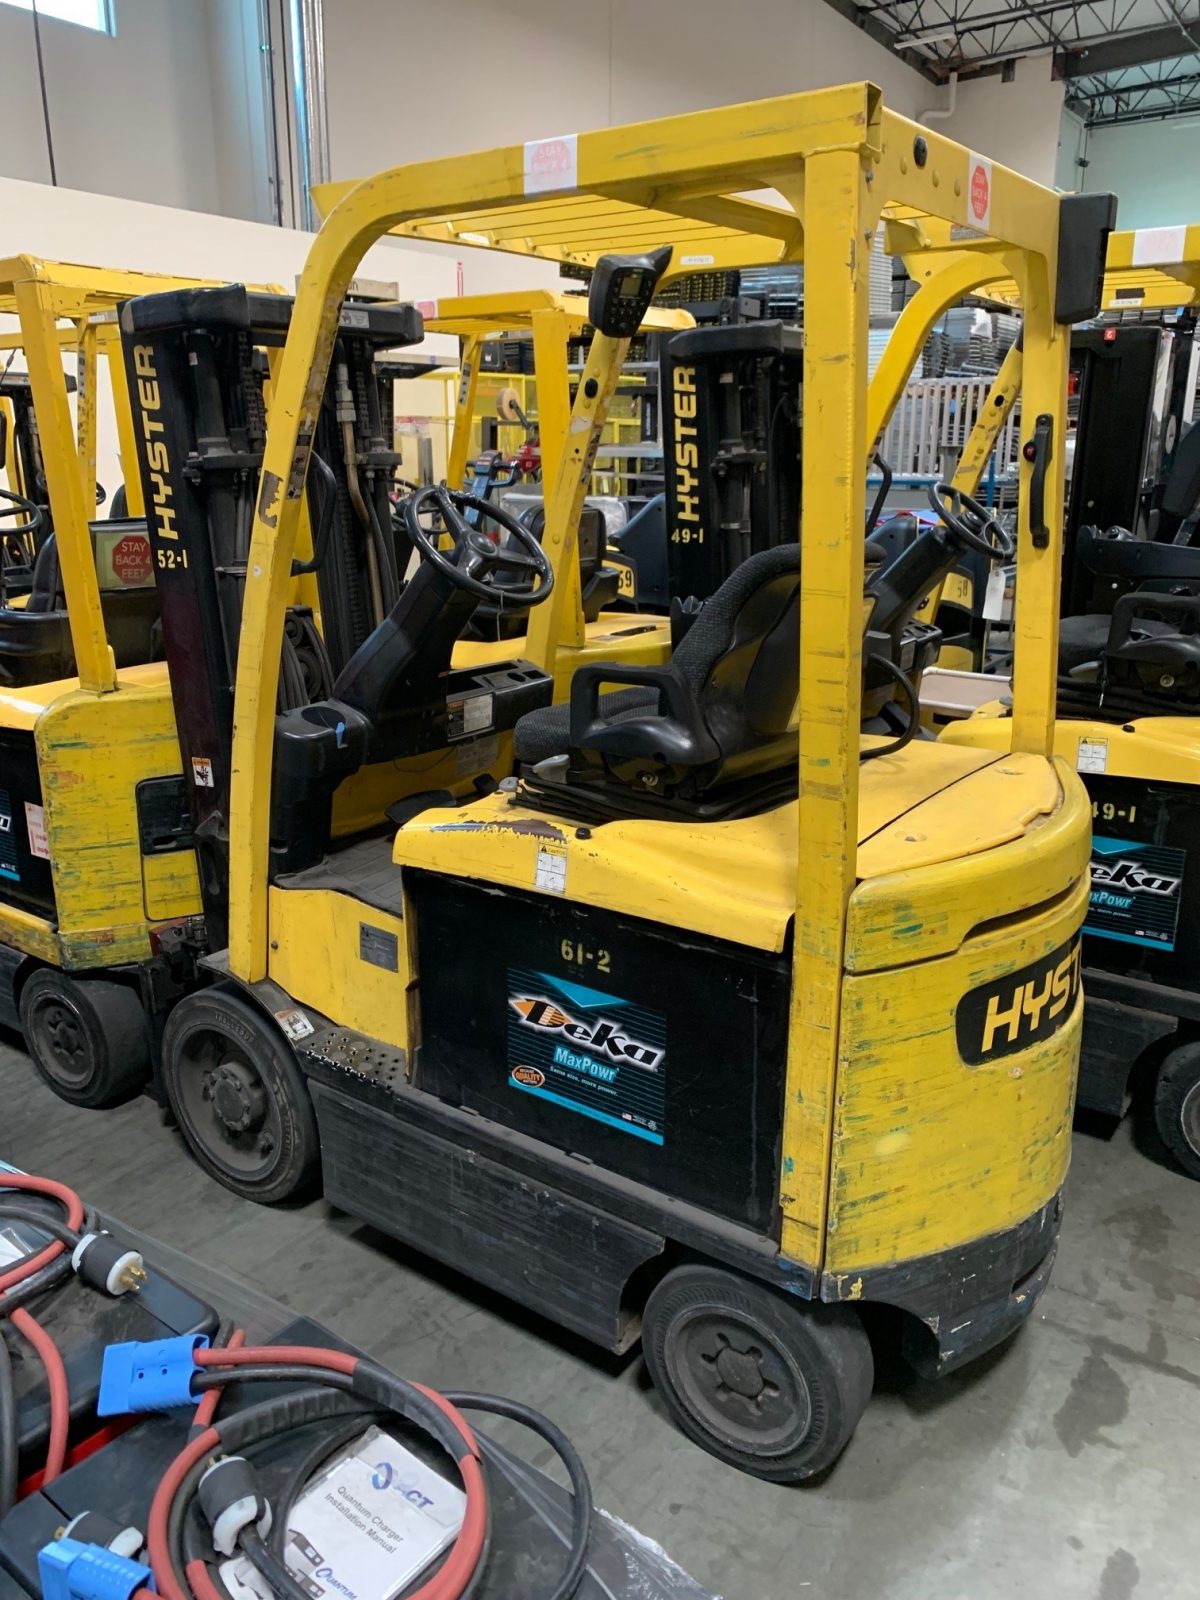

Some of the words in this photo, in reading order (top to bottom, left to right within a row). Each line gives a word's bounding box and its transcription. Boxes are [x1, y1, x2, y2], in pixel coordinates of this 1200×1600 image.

[134, 344, 179, 540] HYSTER
[673, 366, 700, 522] HYSTER
[121, 541, 146, 553] STAY
[671, 528, 704, 544] 49-1
[115, 554, 142, 566] BACK
[145, 554, 152, 565] 4
[121, 568, 145, 579] FEET
[157, 549, 188, 569] 52-1
[1089, 862, 1178, 894] eka
[1089, 891, 1133, 908] xPowr
[561, 939, 611, 974] 61-2
[511, 998, 658, 1066] Deka
[515, 1071, 542, 1081] QUALITY
[550, 1065, 566, 1077] Same
[581, 1078, 597, 1088] more
[555, 1047, 616, 1081] MaxPowr
[324, 1493, 367, 1532] Installation
[366, 1528, 397, 1554] Manual
[337, 1486, 372, 1519] Quantum
[371, 1516, 404, 1543] Charger
[315, 1567, 358, 1600] QUANTUM
